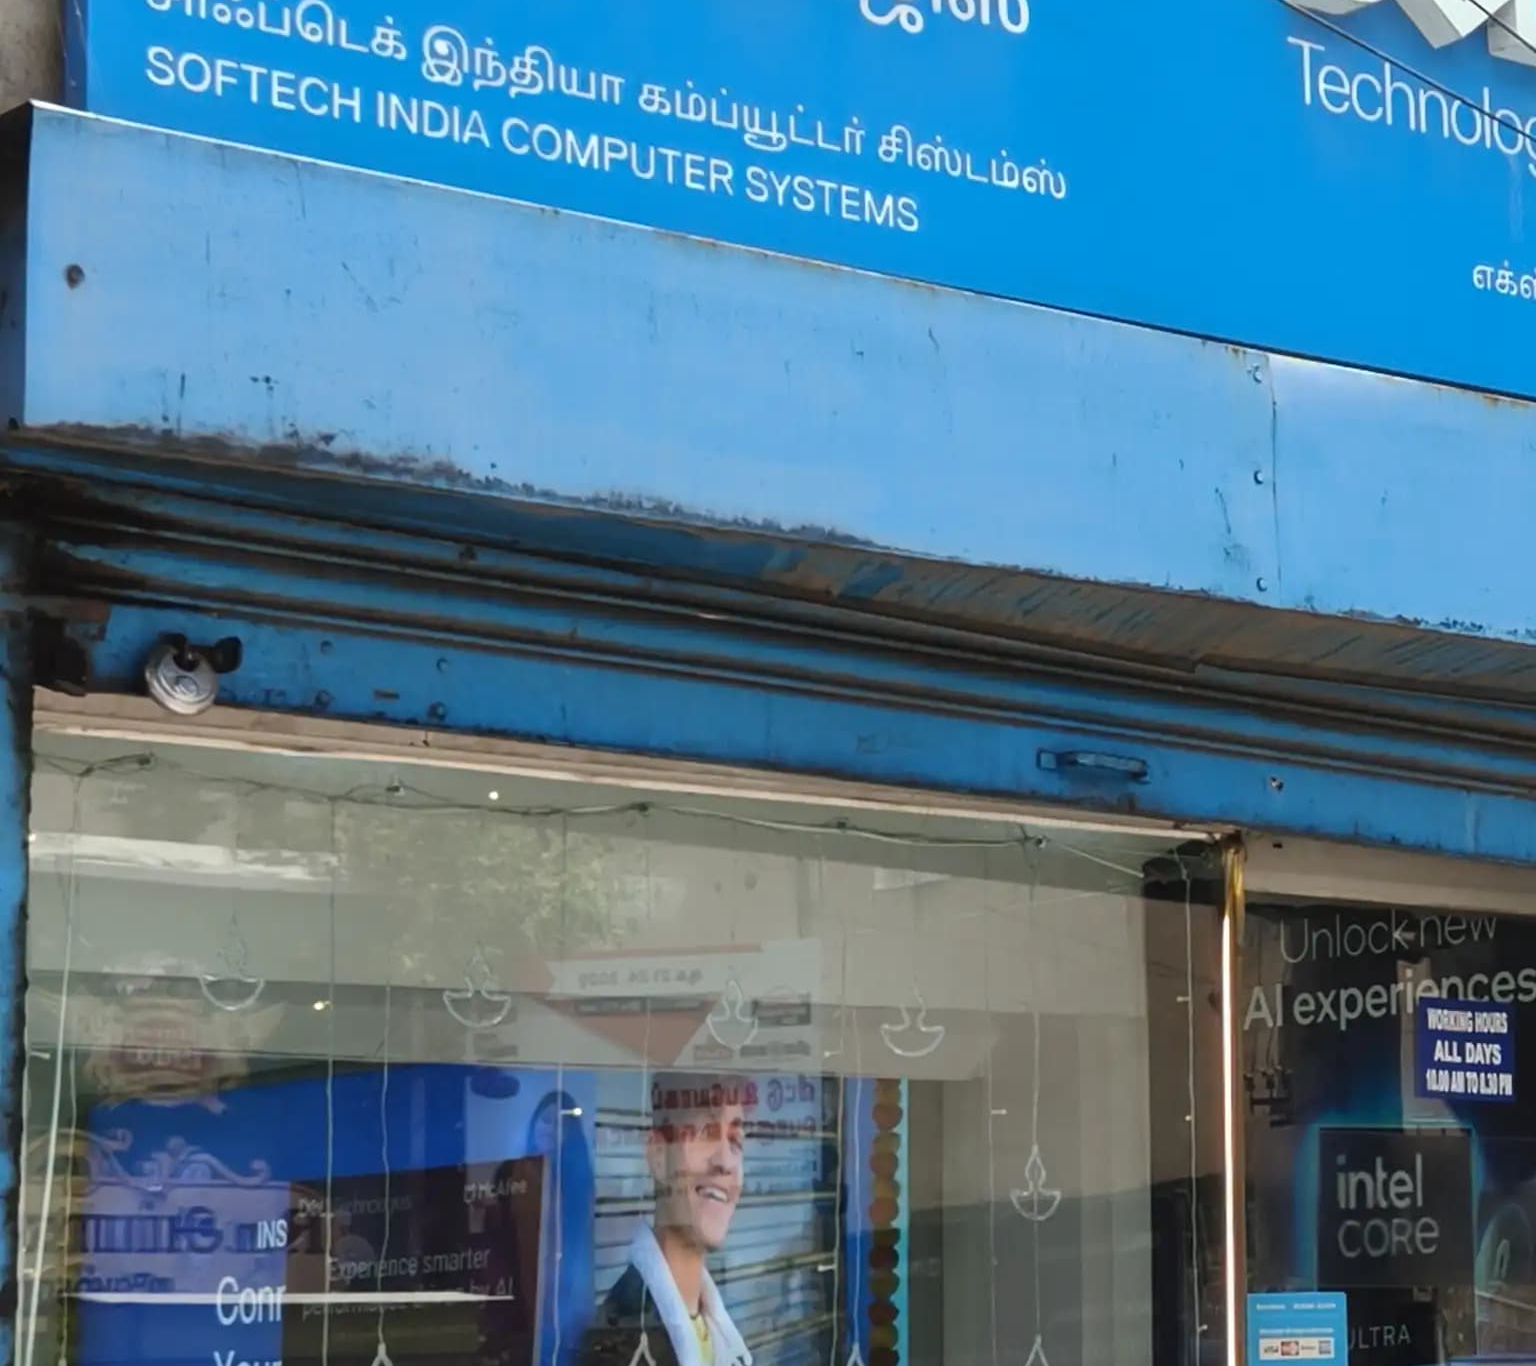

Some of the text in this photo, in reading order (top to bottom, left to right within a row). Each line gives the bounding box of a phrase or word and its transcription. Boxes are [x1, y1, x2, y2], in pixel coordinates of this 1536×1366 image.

[421, 24, 625, 105] இந்தியா
[638, 80, 865, 155] கம்ப்யூட்டர்
[877, 124, 1067, 200] சிஸ்டம்ஸ்
[145, 45, 920, 233] SOFTECH INDIA COMPUTER SYSTEMS
[1279, 909, 1497, 964] Unlock new
[1244, 982, 1284, 1031] AI
[1427, 1007, 1508, 1034] WORKING HOURS
[1434, 1039, 1502, 1065] ALL DAYS
[1466, 1071, 1478, 1094] TO
[1336, 1153, 1424, 1211] intel
[423, 1247, 491, 1274] smarter
